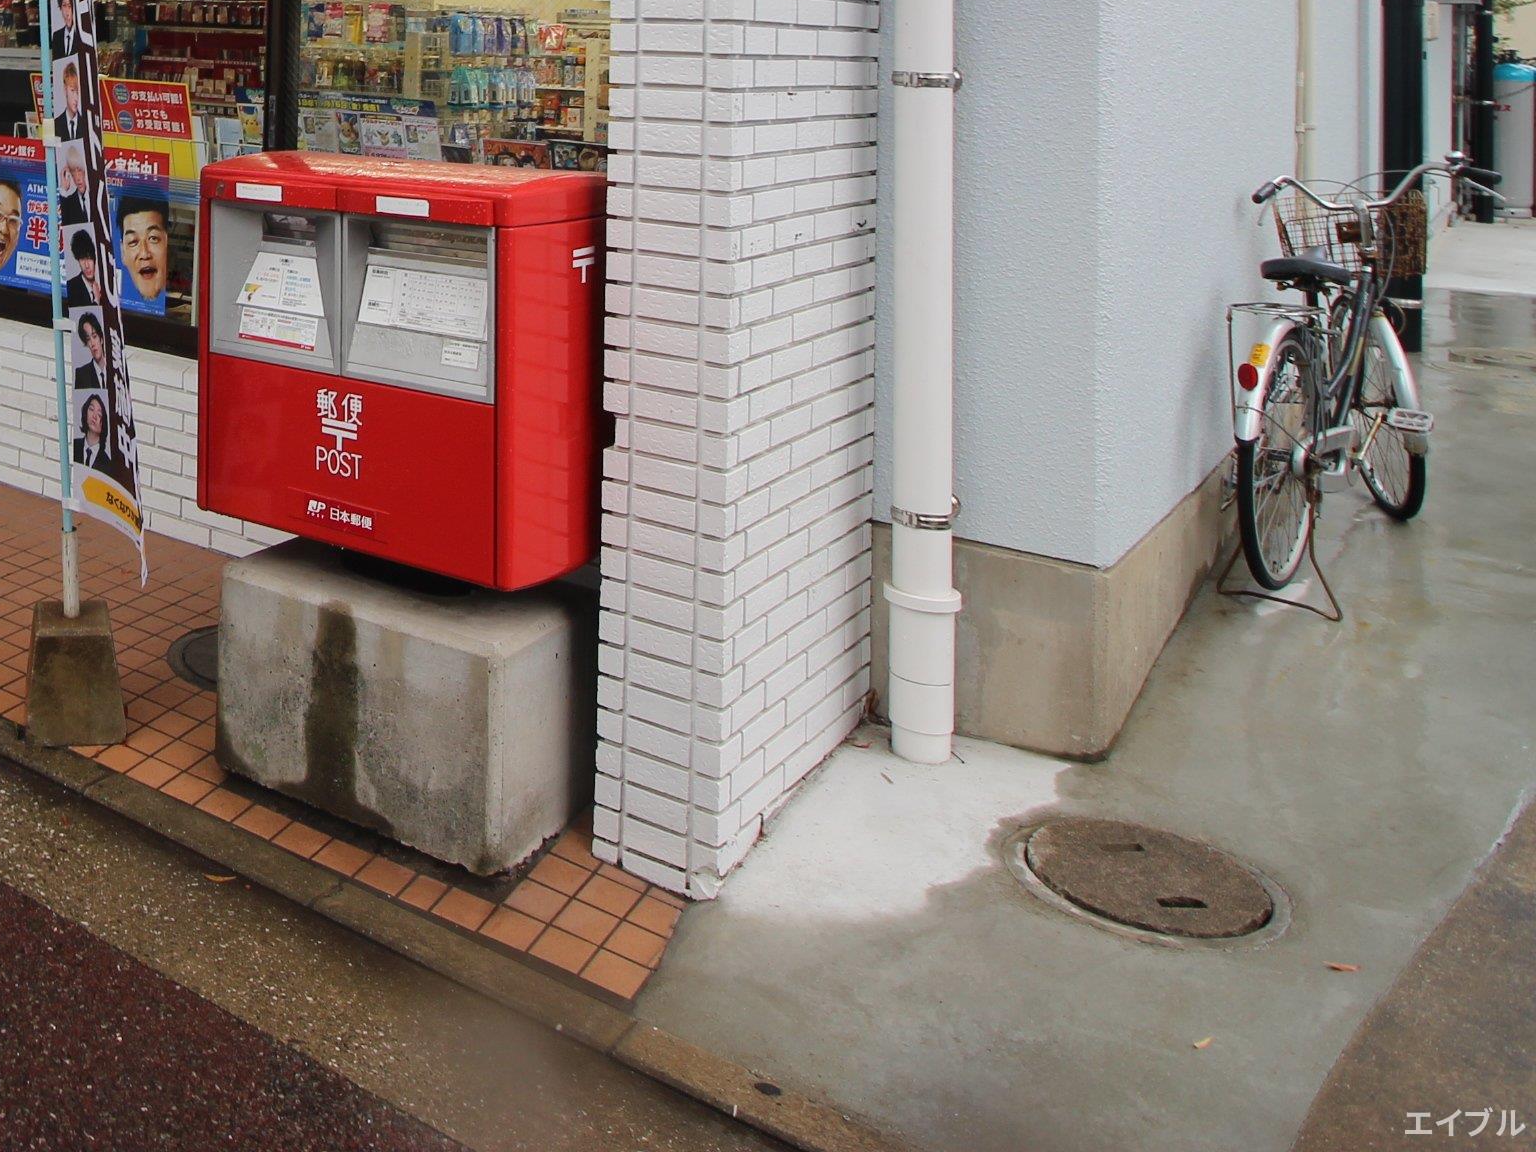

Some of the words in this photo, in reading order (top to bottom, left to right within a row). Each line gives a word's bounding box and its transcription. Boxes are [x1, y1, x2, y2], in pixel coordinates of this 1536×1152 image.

[130, 90, 183, 104] お支払い可能!
[134, 108, 169, 120] いつでも
[316, 388, 363, 426] 郵便
[316, 445, 362, 480] POST
[330, 507, 373, 530] 日本郵便
